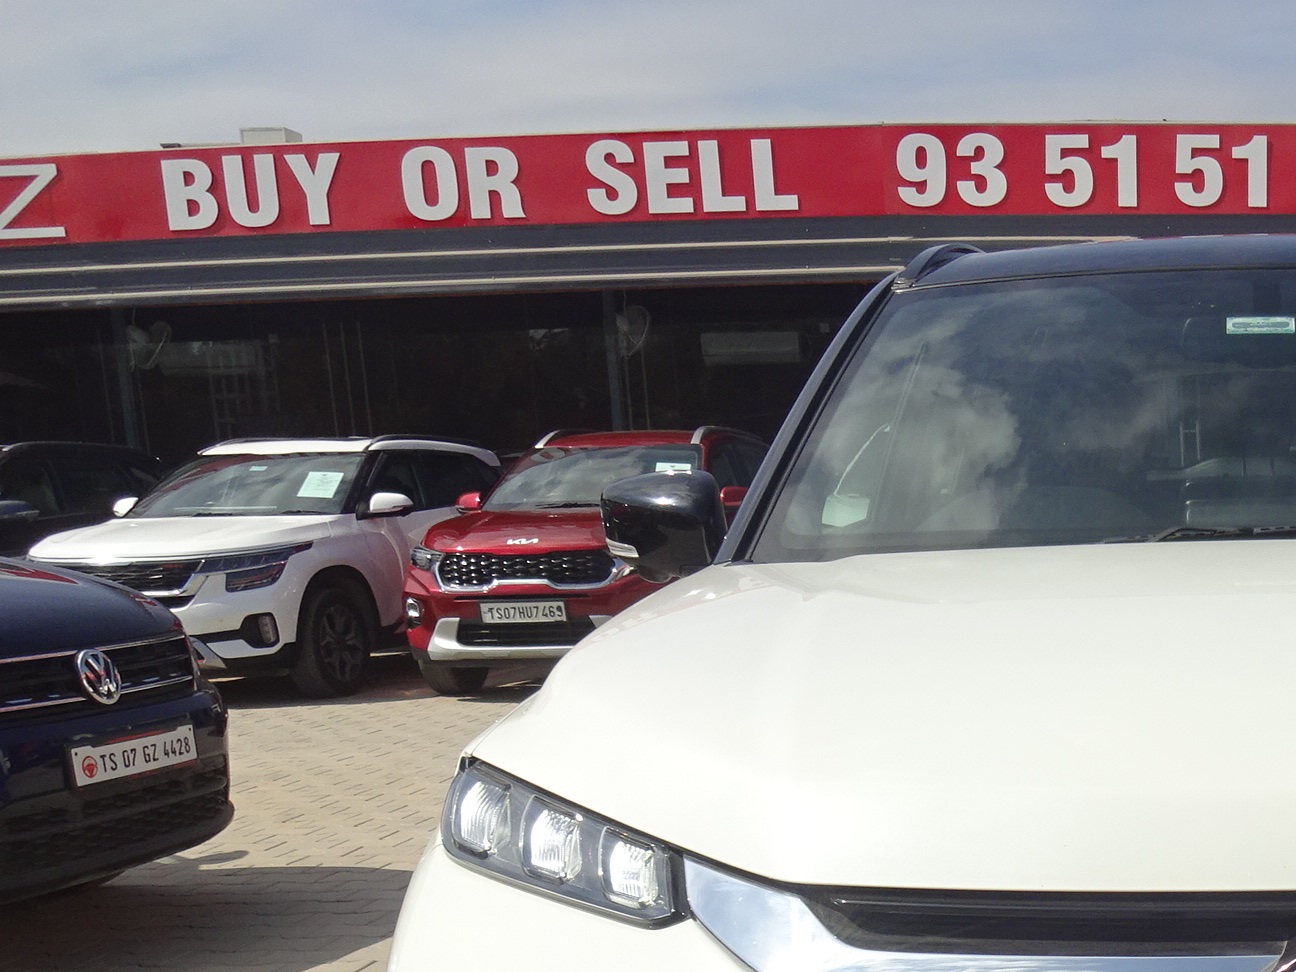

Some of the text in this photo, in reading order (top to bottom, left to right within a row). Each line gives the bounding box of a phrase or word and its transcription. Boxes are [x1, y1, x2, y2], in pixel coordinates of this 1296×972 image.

[160, 138, 799, 232] BUY OR SELL
[896, 133, 1007, 208] 93
[1043, 133, 1139, 208] 51
[1173, 133, 1268, 208] 51
[488, 605, 564, 620] TS07HU7469
[100, 736, 191, 773] TS 07 GZ 4428
